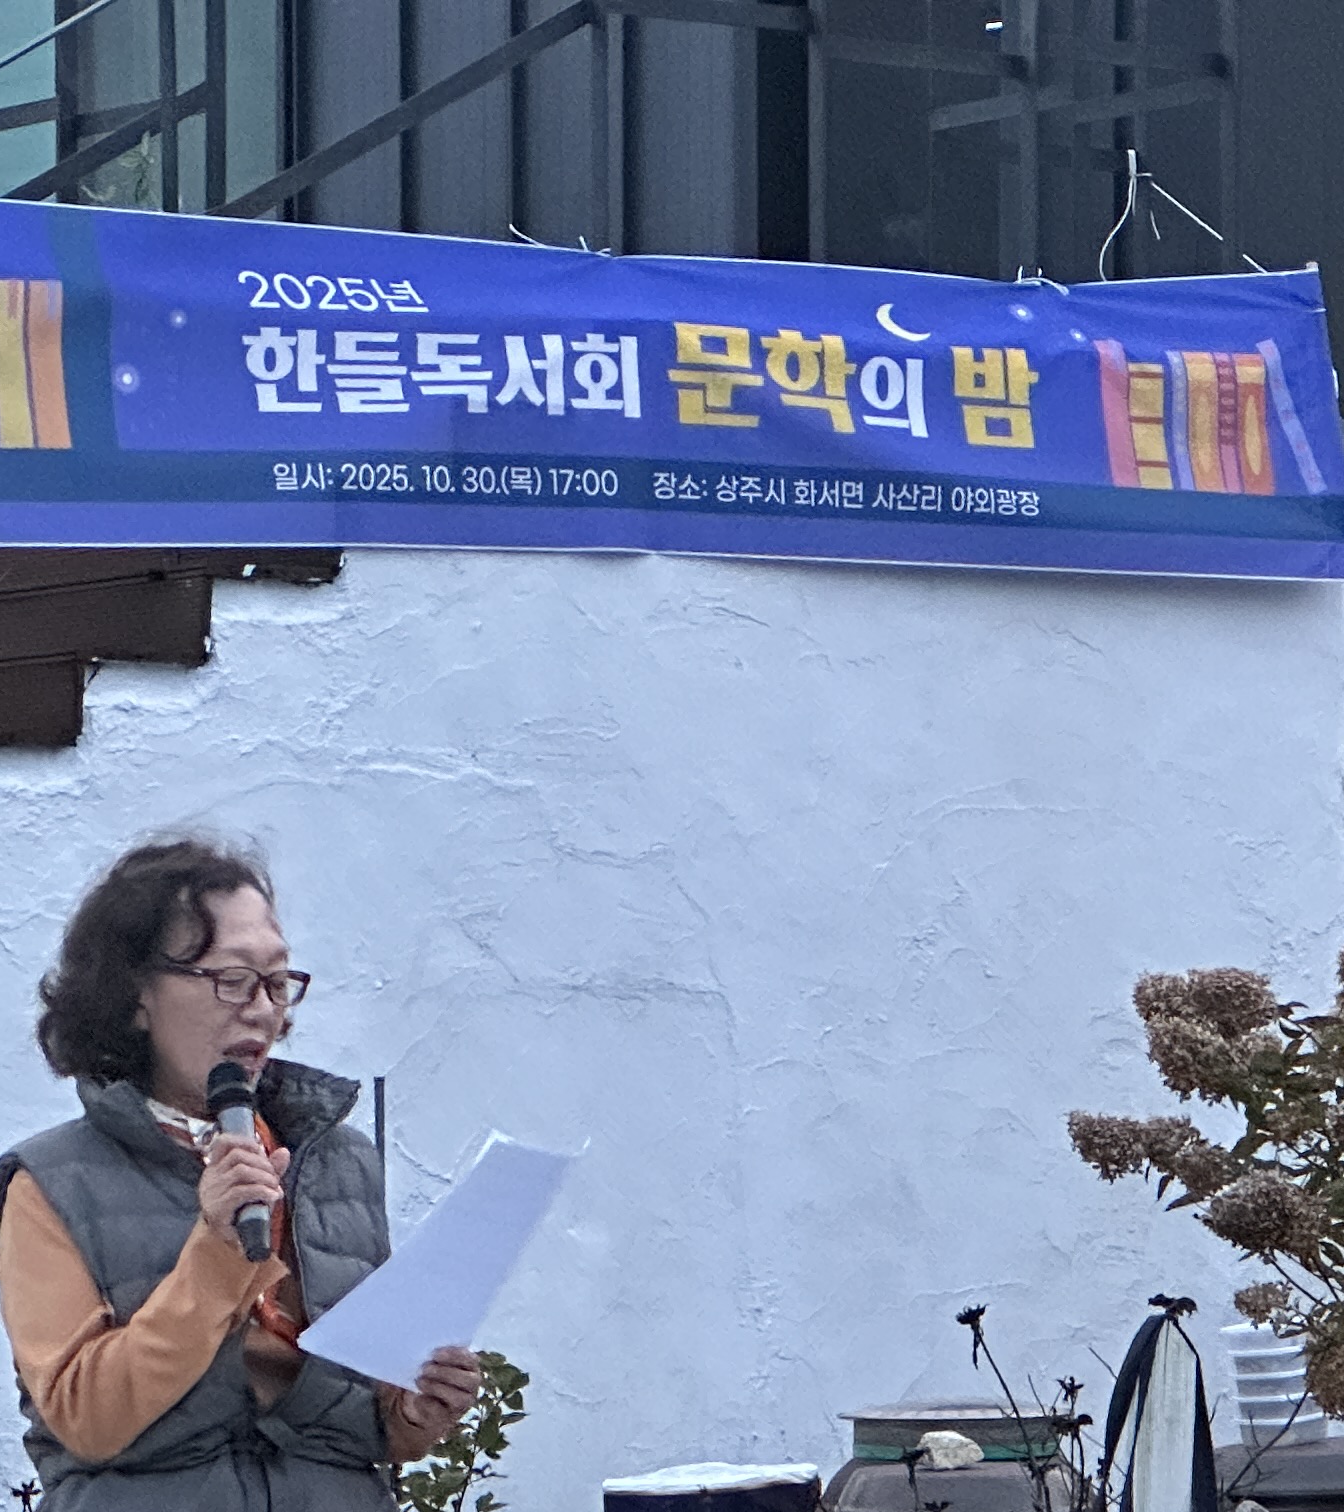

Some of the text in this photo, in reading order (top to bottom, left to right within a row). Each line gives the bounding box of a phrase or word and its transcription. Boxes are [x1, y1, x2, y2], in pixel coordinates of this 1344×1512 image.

[237, 270, 429, 314] 2025년
[241, 321, 1040, 449] 한들독서회 문학의 밤
[272, 461, 619, 496] 일시: 2025. 10. 30.(목) 17:00
[652, 471, 1041, 516] 장소: 상주시 화서면 사산리 야외광장
